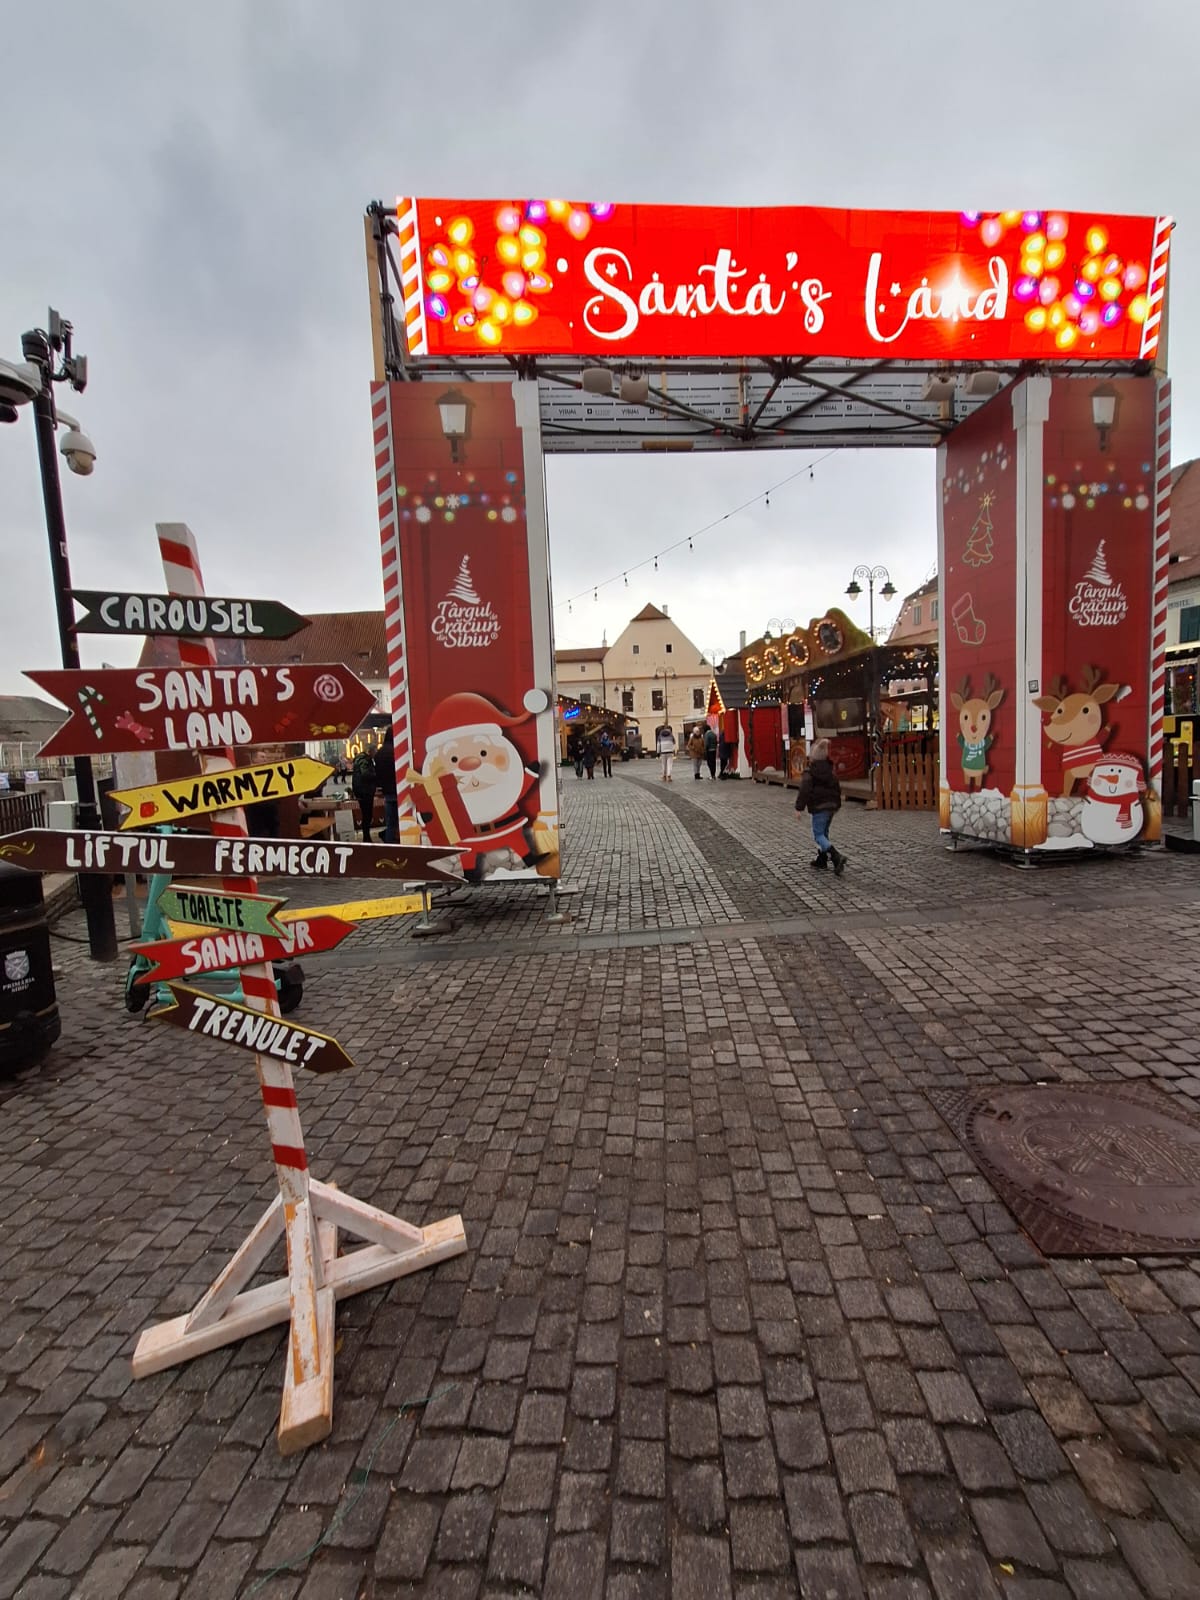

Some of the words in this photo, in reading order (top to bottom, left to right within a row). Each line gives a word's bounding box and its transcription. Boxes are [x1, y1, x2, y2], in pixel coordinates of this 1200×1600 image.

[583, 247, 833, 340] Santa's
[865, 252, 1008, 343] Land
[1068, 595, 1129, 614] Crăciun
[1075, 582, 1122, 600] Târgul
[100, 597, 264, 635] CAROUSEL
[431, 615, 501, 634] Crăciun
[437, 601, 492, 620] Târgul
[135, 667, 296, 712] SANTA'S
[166, 710, 253, 750] LAND
[162, 763, 298, 814] WARMZY
[214, 839, 354, 875] FERMECAT
[176, 892, 245, 927] TOALETE
[279, 921, 314, 953] VR
